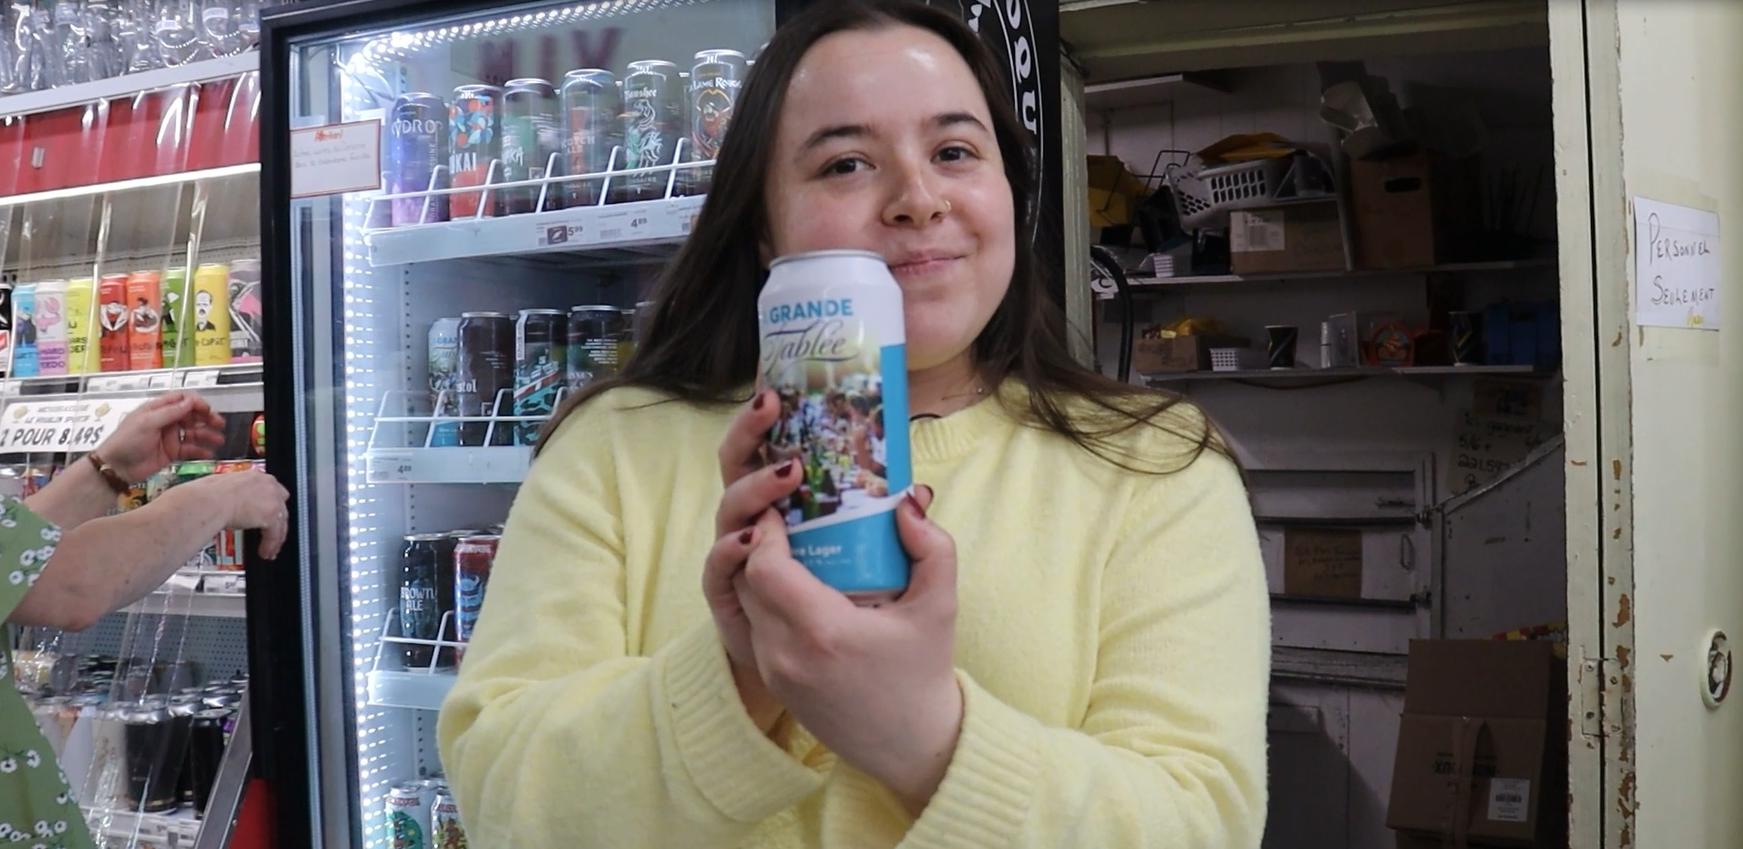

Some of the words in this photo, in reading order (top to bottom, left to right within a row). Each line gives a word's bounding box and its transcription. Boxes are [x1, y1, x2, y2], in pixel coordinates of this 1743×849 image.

[1648, 212, 1711, 264] PERSONNEL
[769, 299, 854, 324] GRANDE
[11, 428, 56, 446] POUR
[808, 545, 842, 558] Lager
